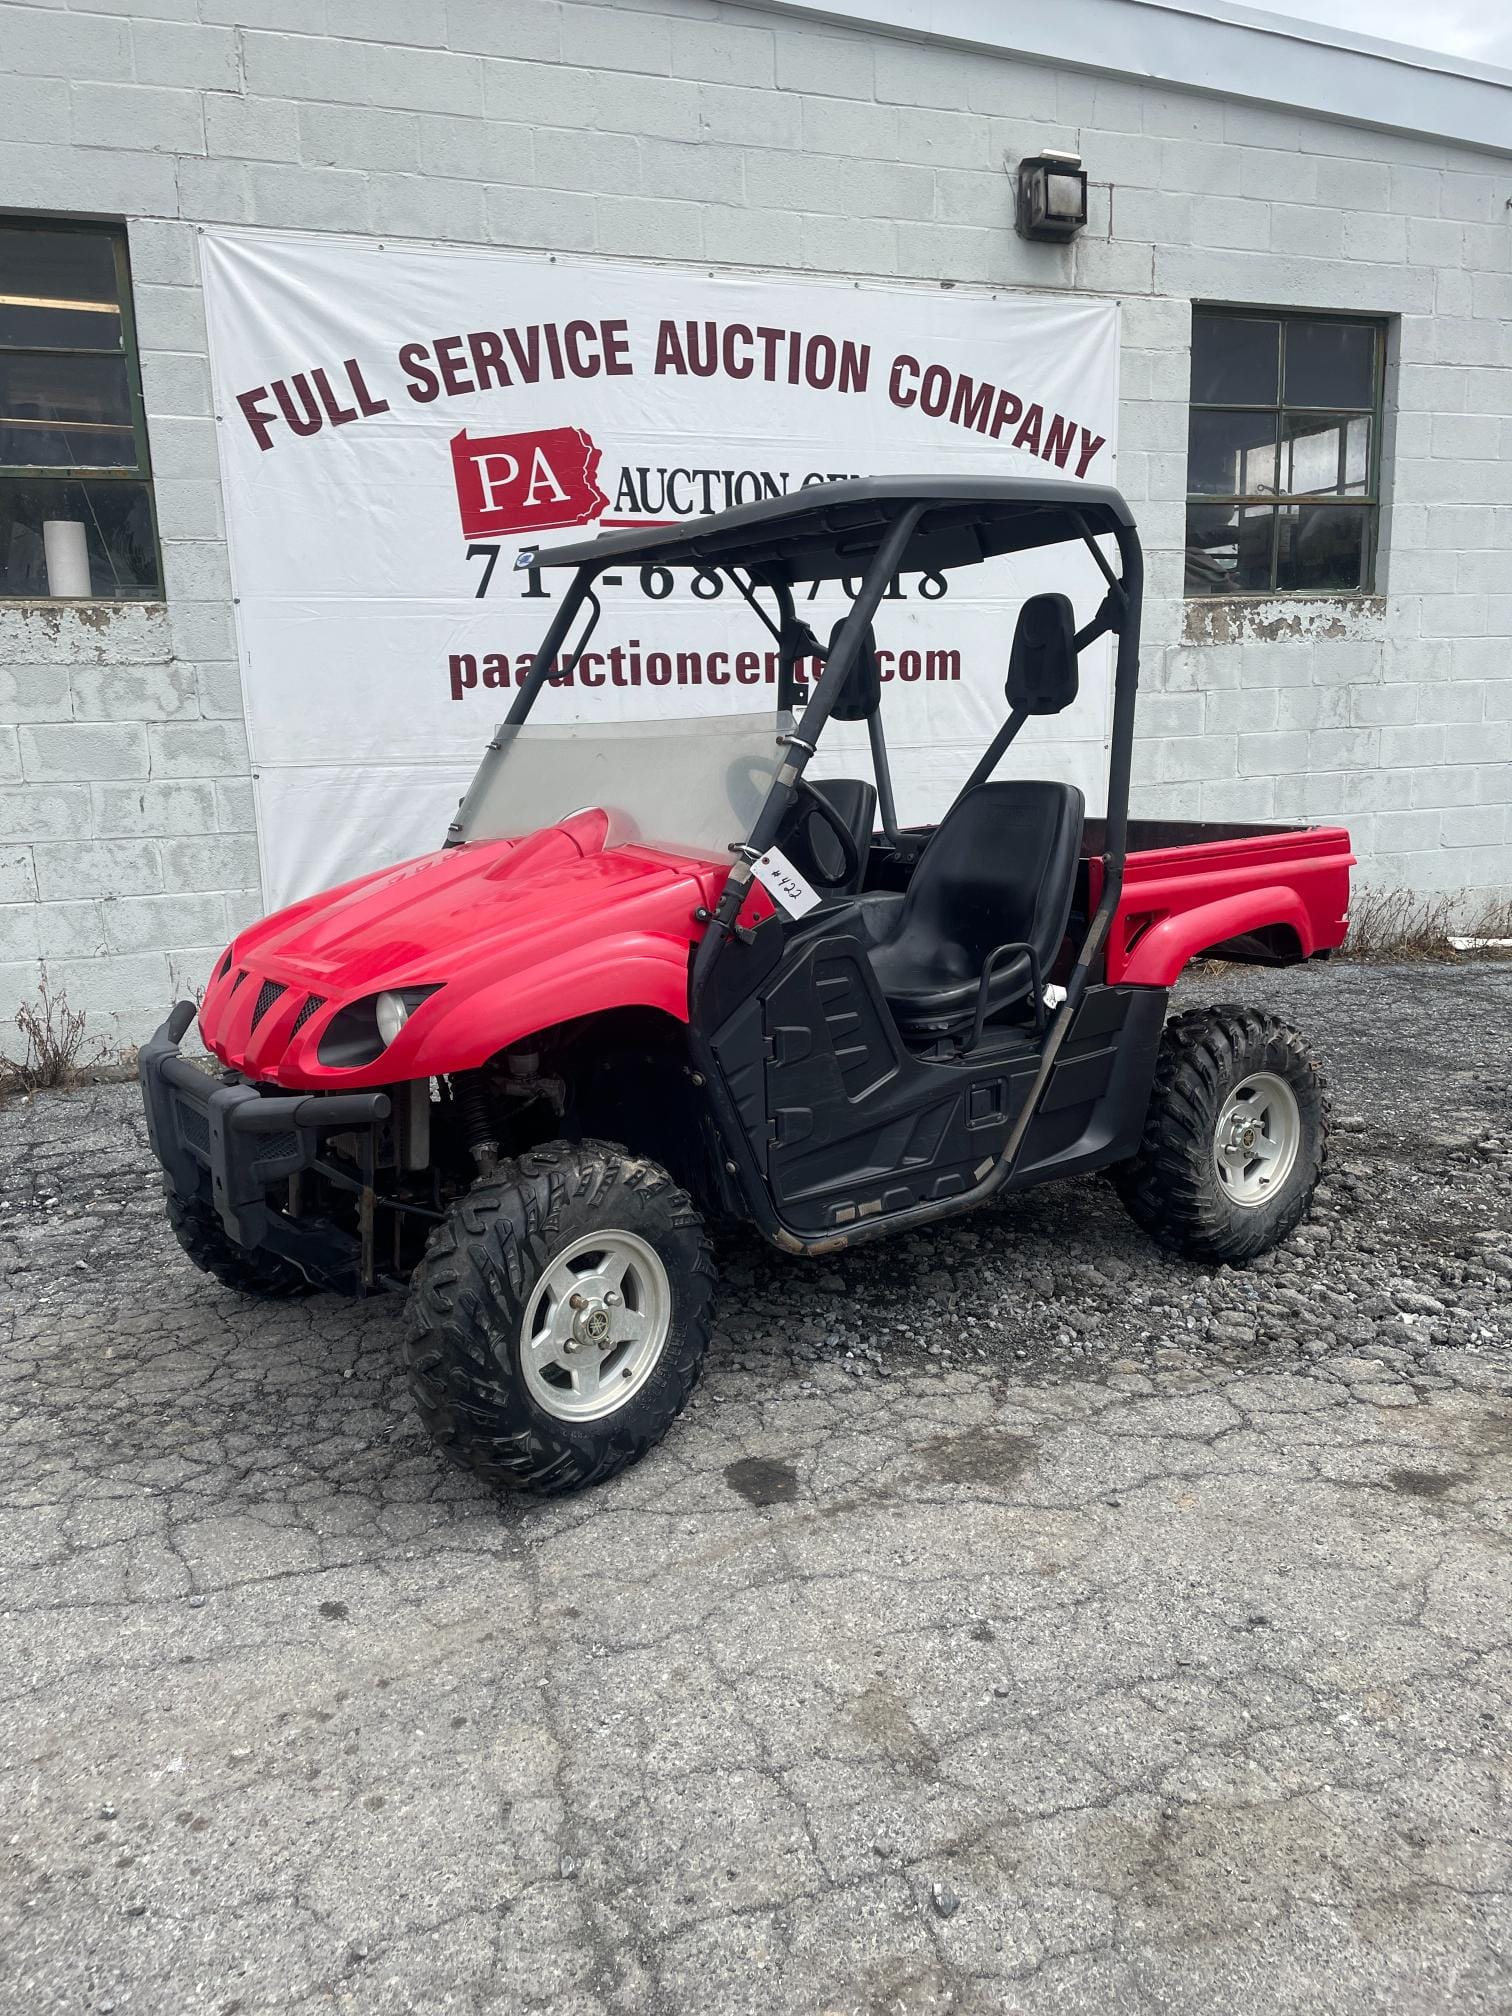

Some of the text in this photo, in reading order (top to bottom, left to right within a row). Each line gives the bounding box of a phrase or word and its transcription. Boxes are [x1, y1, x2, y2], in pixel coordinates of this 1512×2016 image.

[236, 319, 1106, 479] FULL SERVICE AUCTION COMPANY
[470, 446, 790, 514] PA AUCTION
[448, 639, 961, 701] paauctioncentecom
[771, 870, 802, 899] #422
